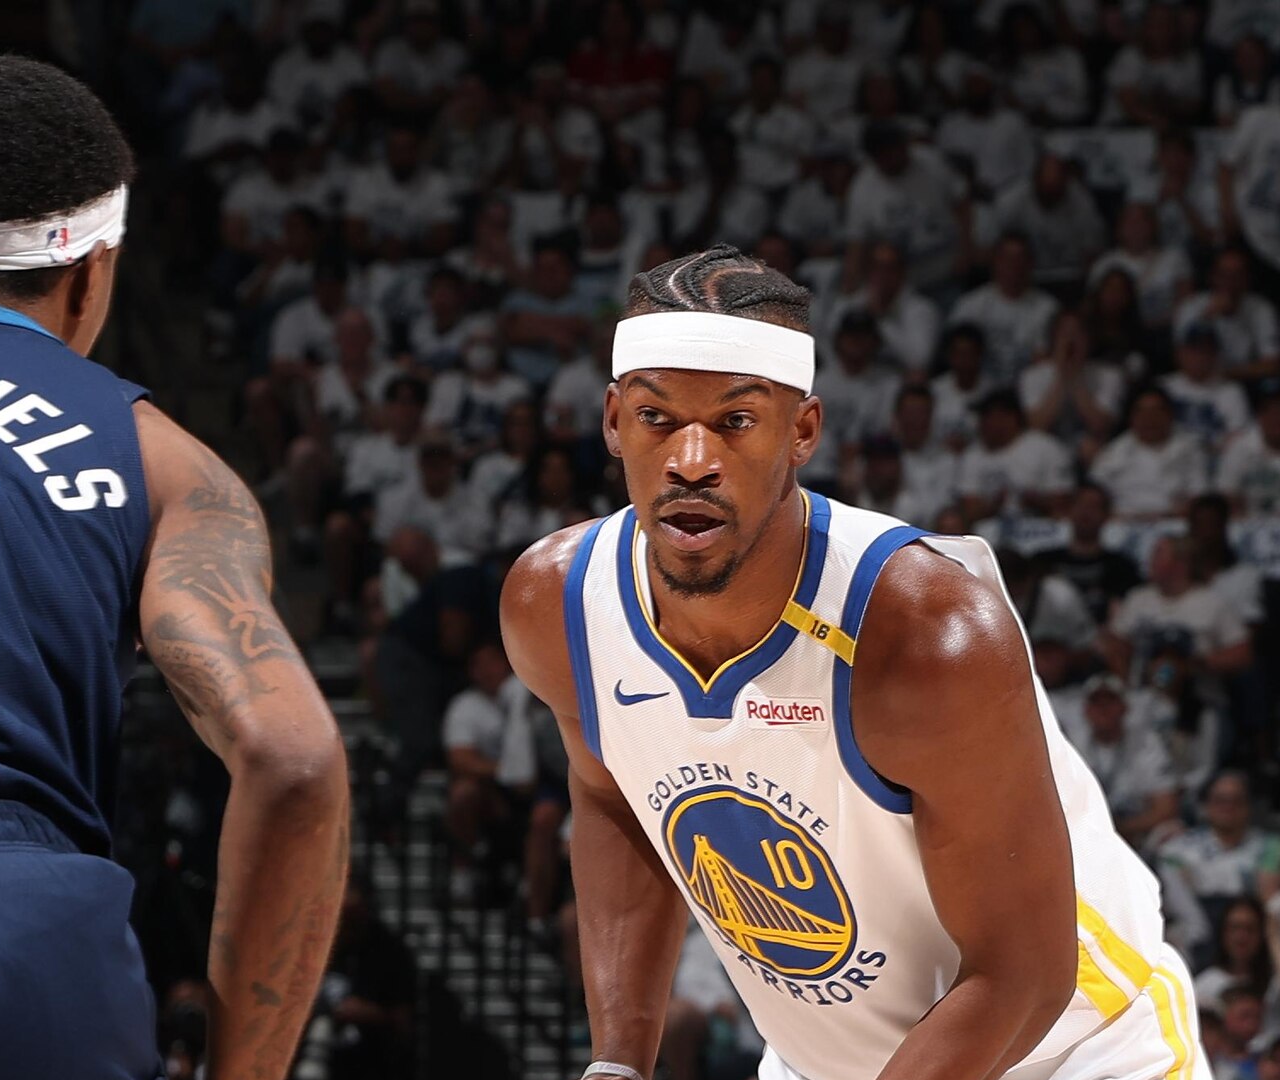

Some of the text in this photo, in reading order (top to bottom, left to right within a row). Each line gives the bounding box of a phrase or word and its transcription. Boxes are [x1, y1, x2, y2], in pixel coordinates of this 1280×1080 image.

[746, 698, 826, 723] Rakuten
[647, 763, 829, 837] GOLDEN STATE
[761, 837, 816, 891] 10
[714, 927, 888, 1006] ARRIORS
